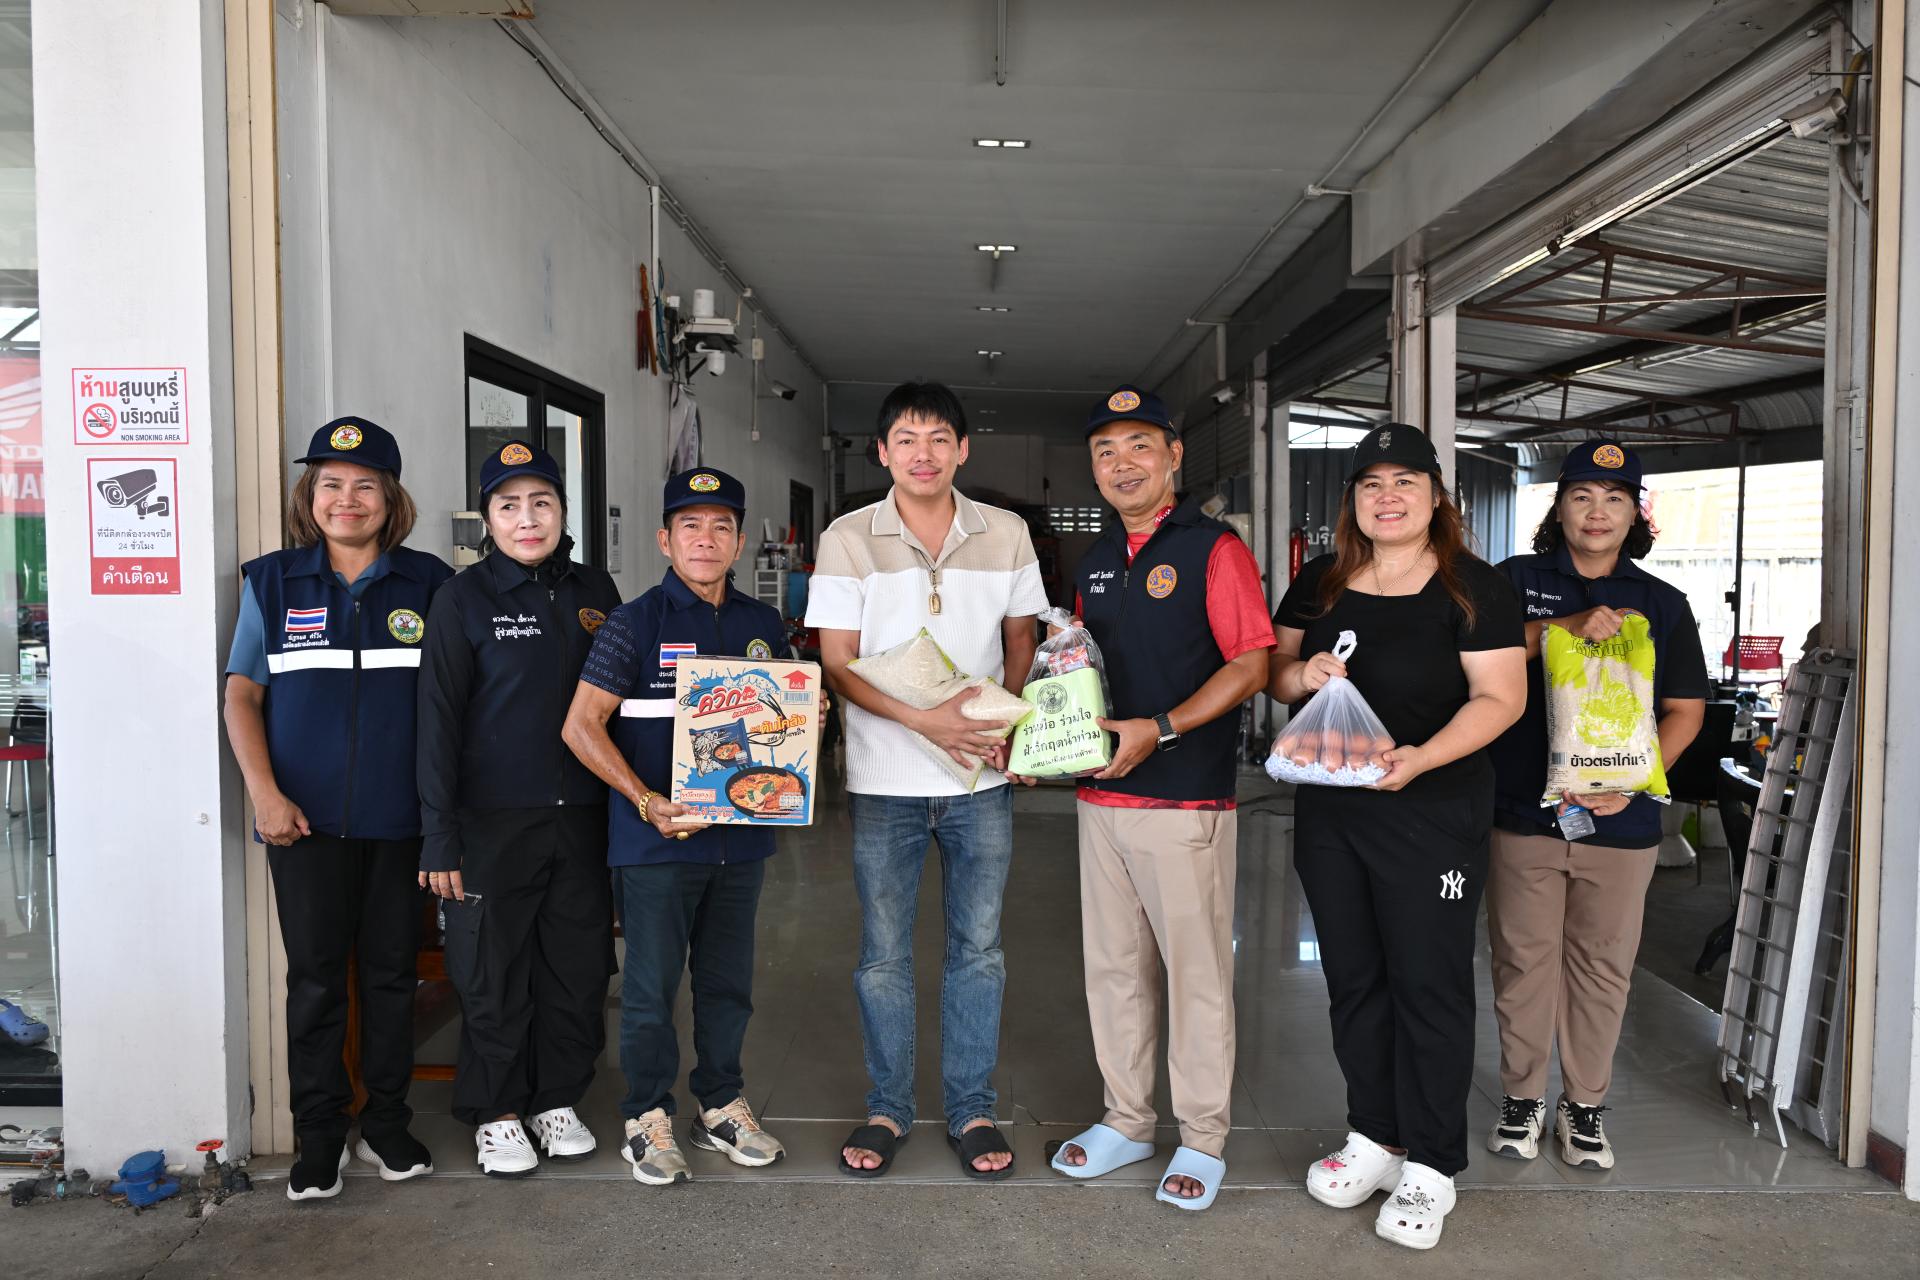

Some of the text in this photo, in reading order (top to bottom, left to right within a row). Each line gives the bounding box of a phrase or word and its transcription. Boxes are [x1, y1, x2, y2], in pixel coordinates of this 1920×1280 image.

[80, 371, 179, 404] ห้ามสูบบุหรี่
[120, 401, 180, 424] บริเวณนี้
[120, 434, 181, 442] NON SMOKING AREA
[118, 542, 128, 550] 24
[103, 564, 169, 584] คำเตือน
[1059, 707, 1092, 726] ร่วมใจ
